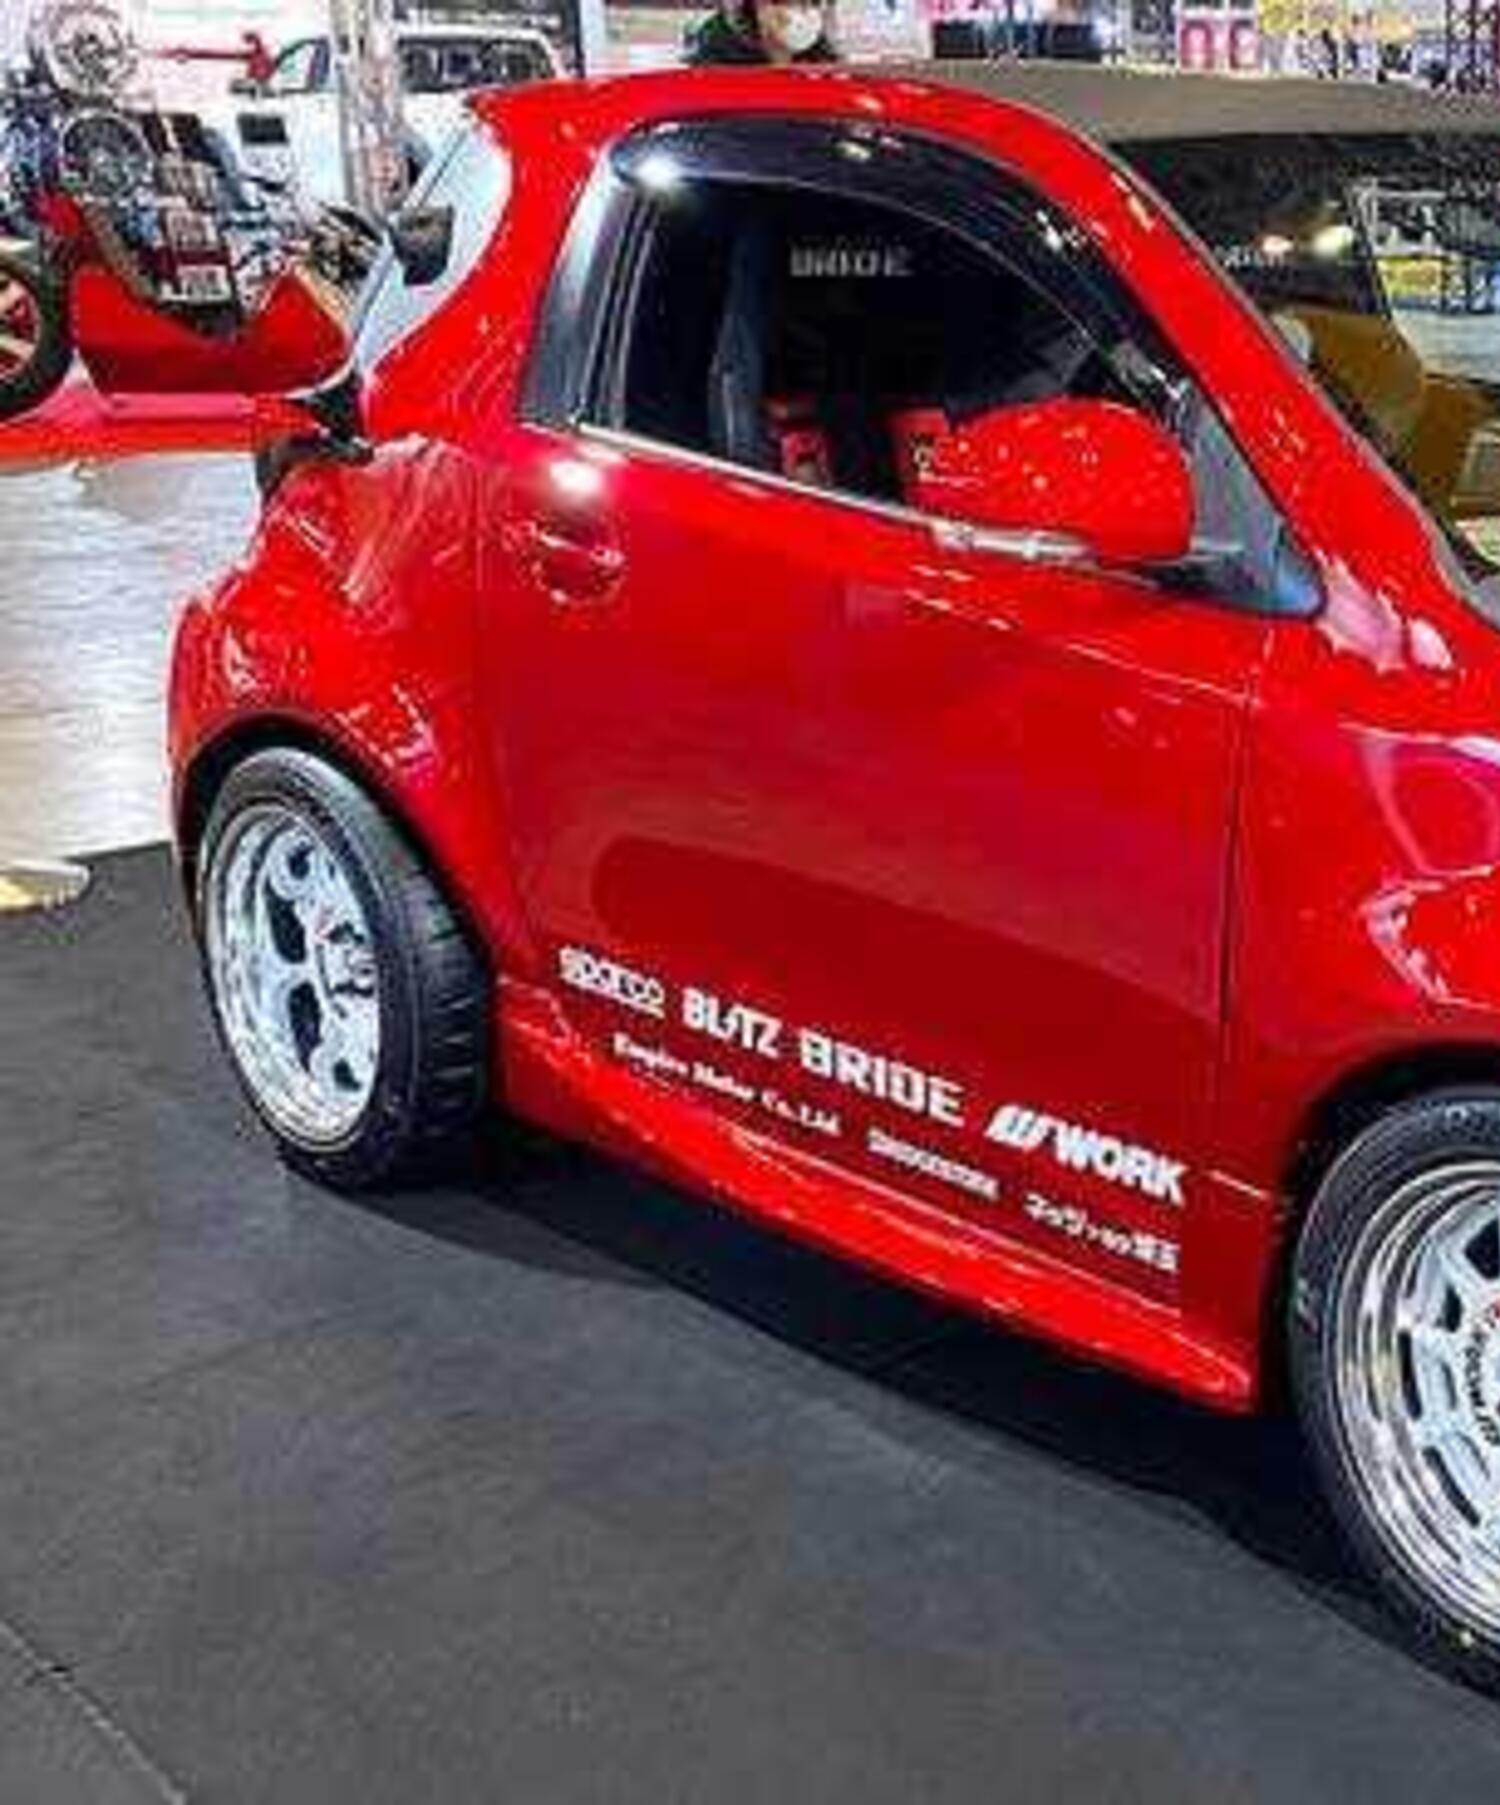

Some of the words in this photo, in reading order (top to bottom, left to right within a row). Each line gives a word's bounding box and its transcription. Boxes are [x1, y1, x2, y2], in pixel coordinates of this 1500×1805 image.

[682, 986, 782, 1059] BLITZ
[799, 1026, 966, 1128] BRIDE
[1048, 1116, 1187, 1207] WORK
